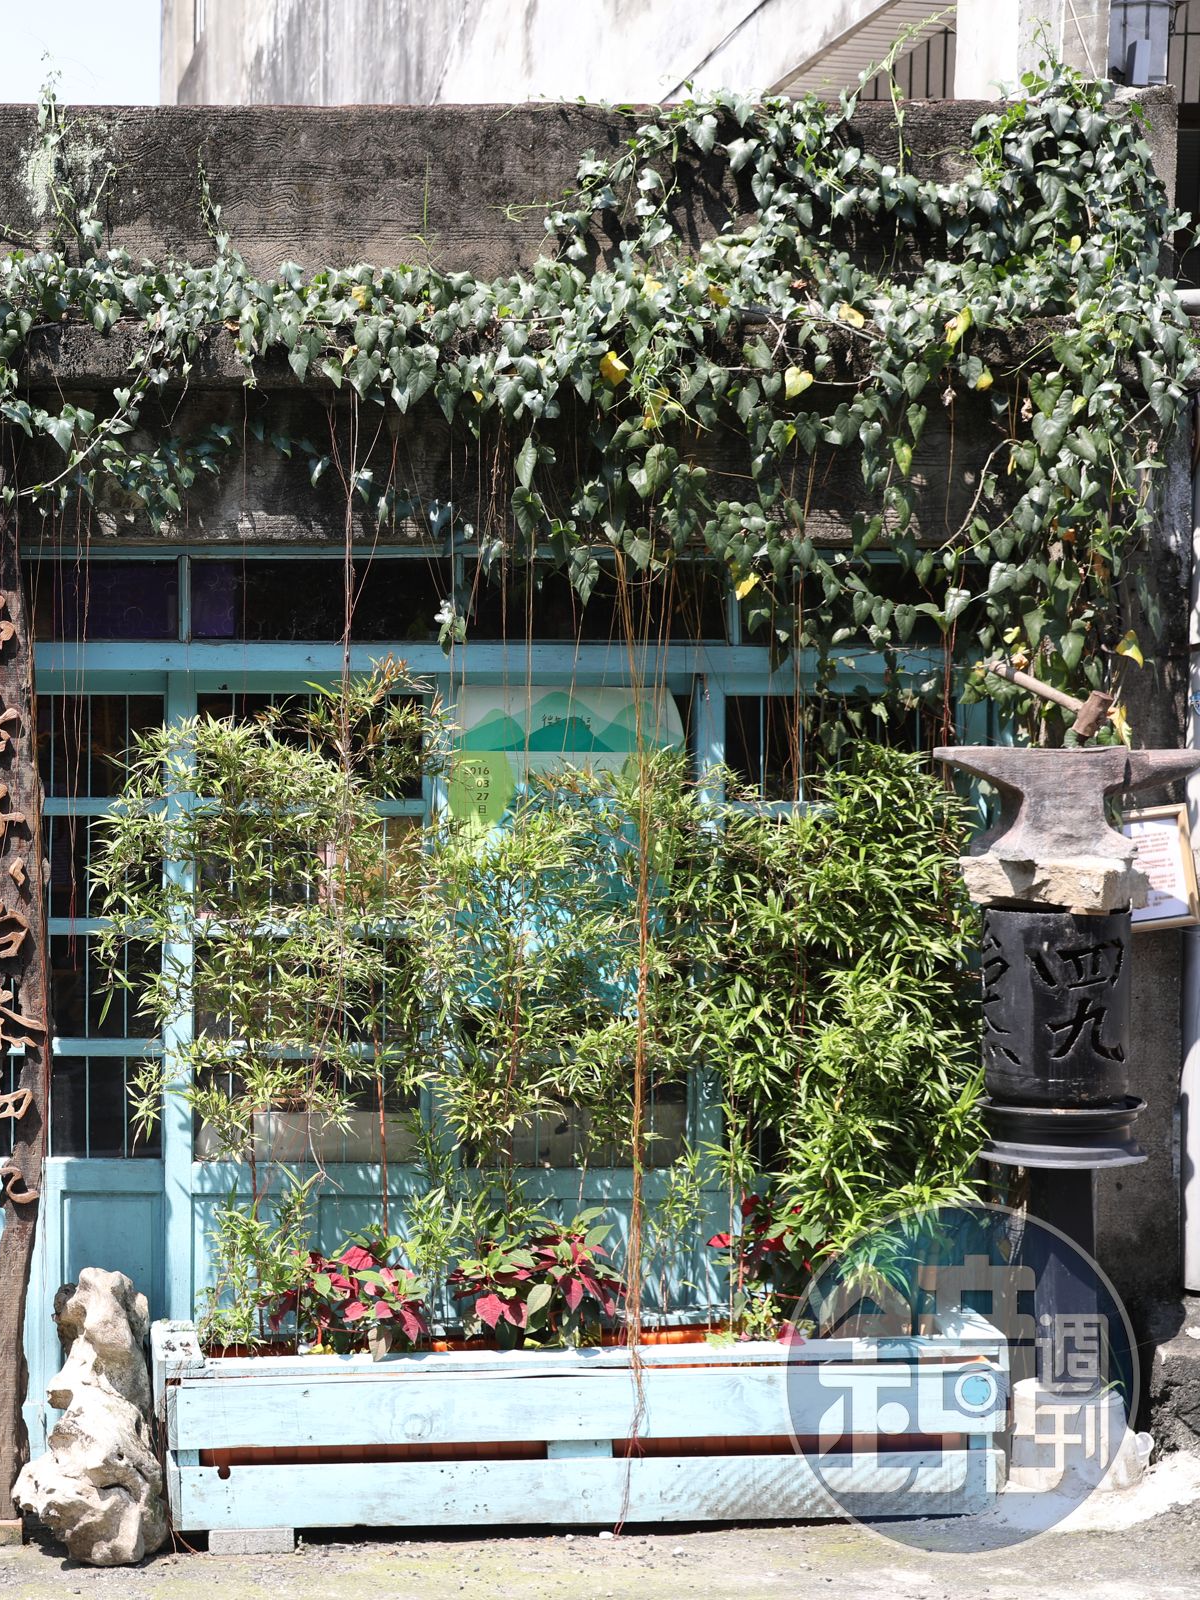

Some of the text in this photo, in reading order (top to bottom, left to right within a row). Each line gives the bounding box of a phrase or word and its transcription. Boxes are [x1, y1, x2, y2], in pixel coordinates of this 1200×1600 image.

[476, 780, 490, 788] 03
[476, 793, 490, 801] 27
[479, 805, 487, 813] 日
[1024, 937, 1126, 1063] 四九
